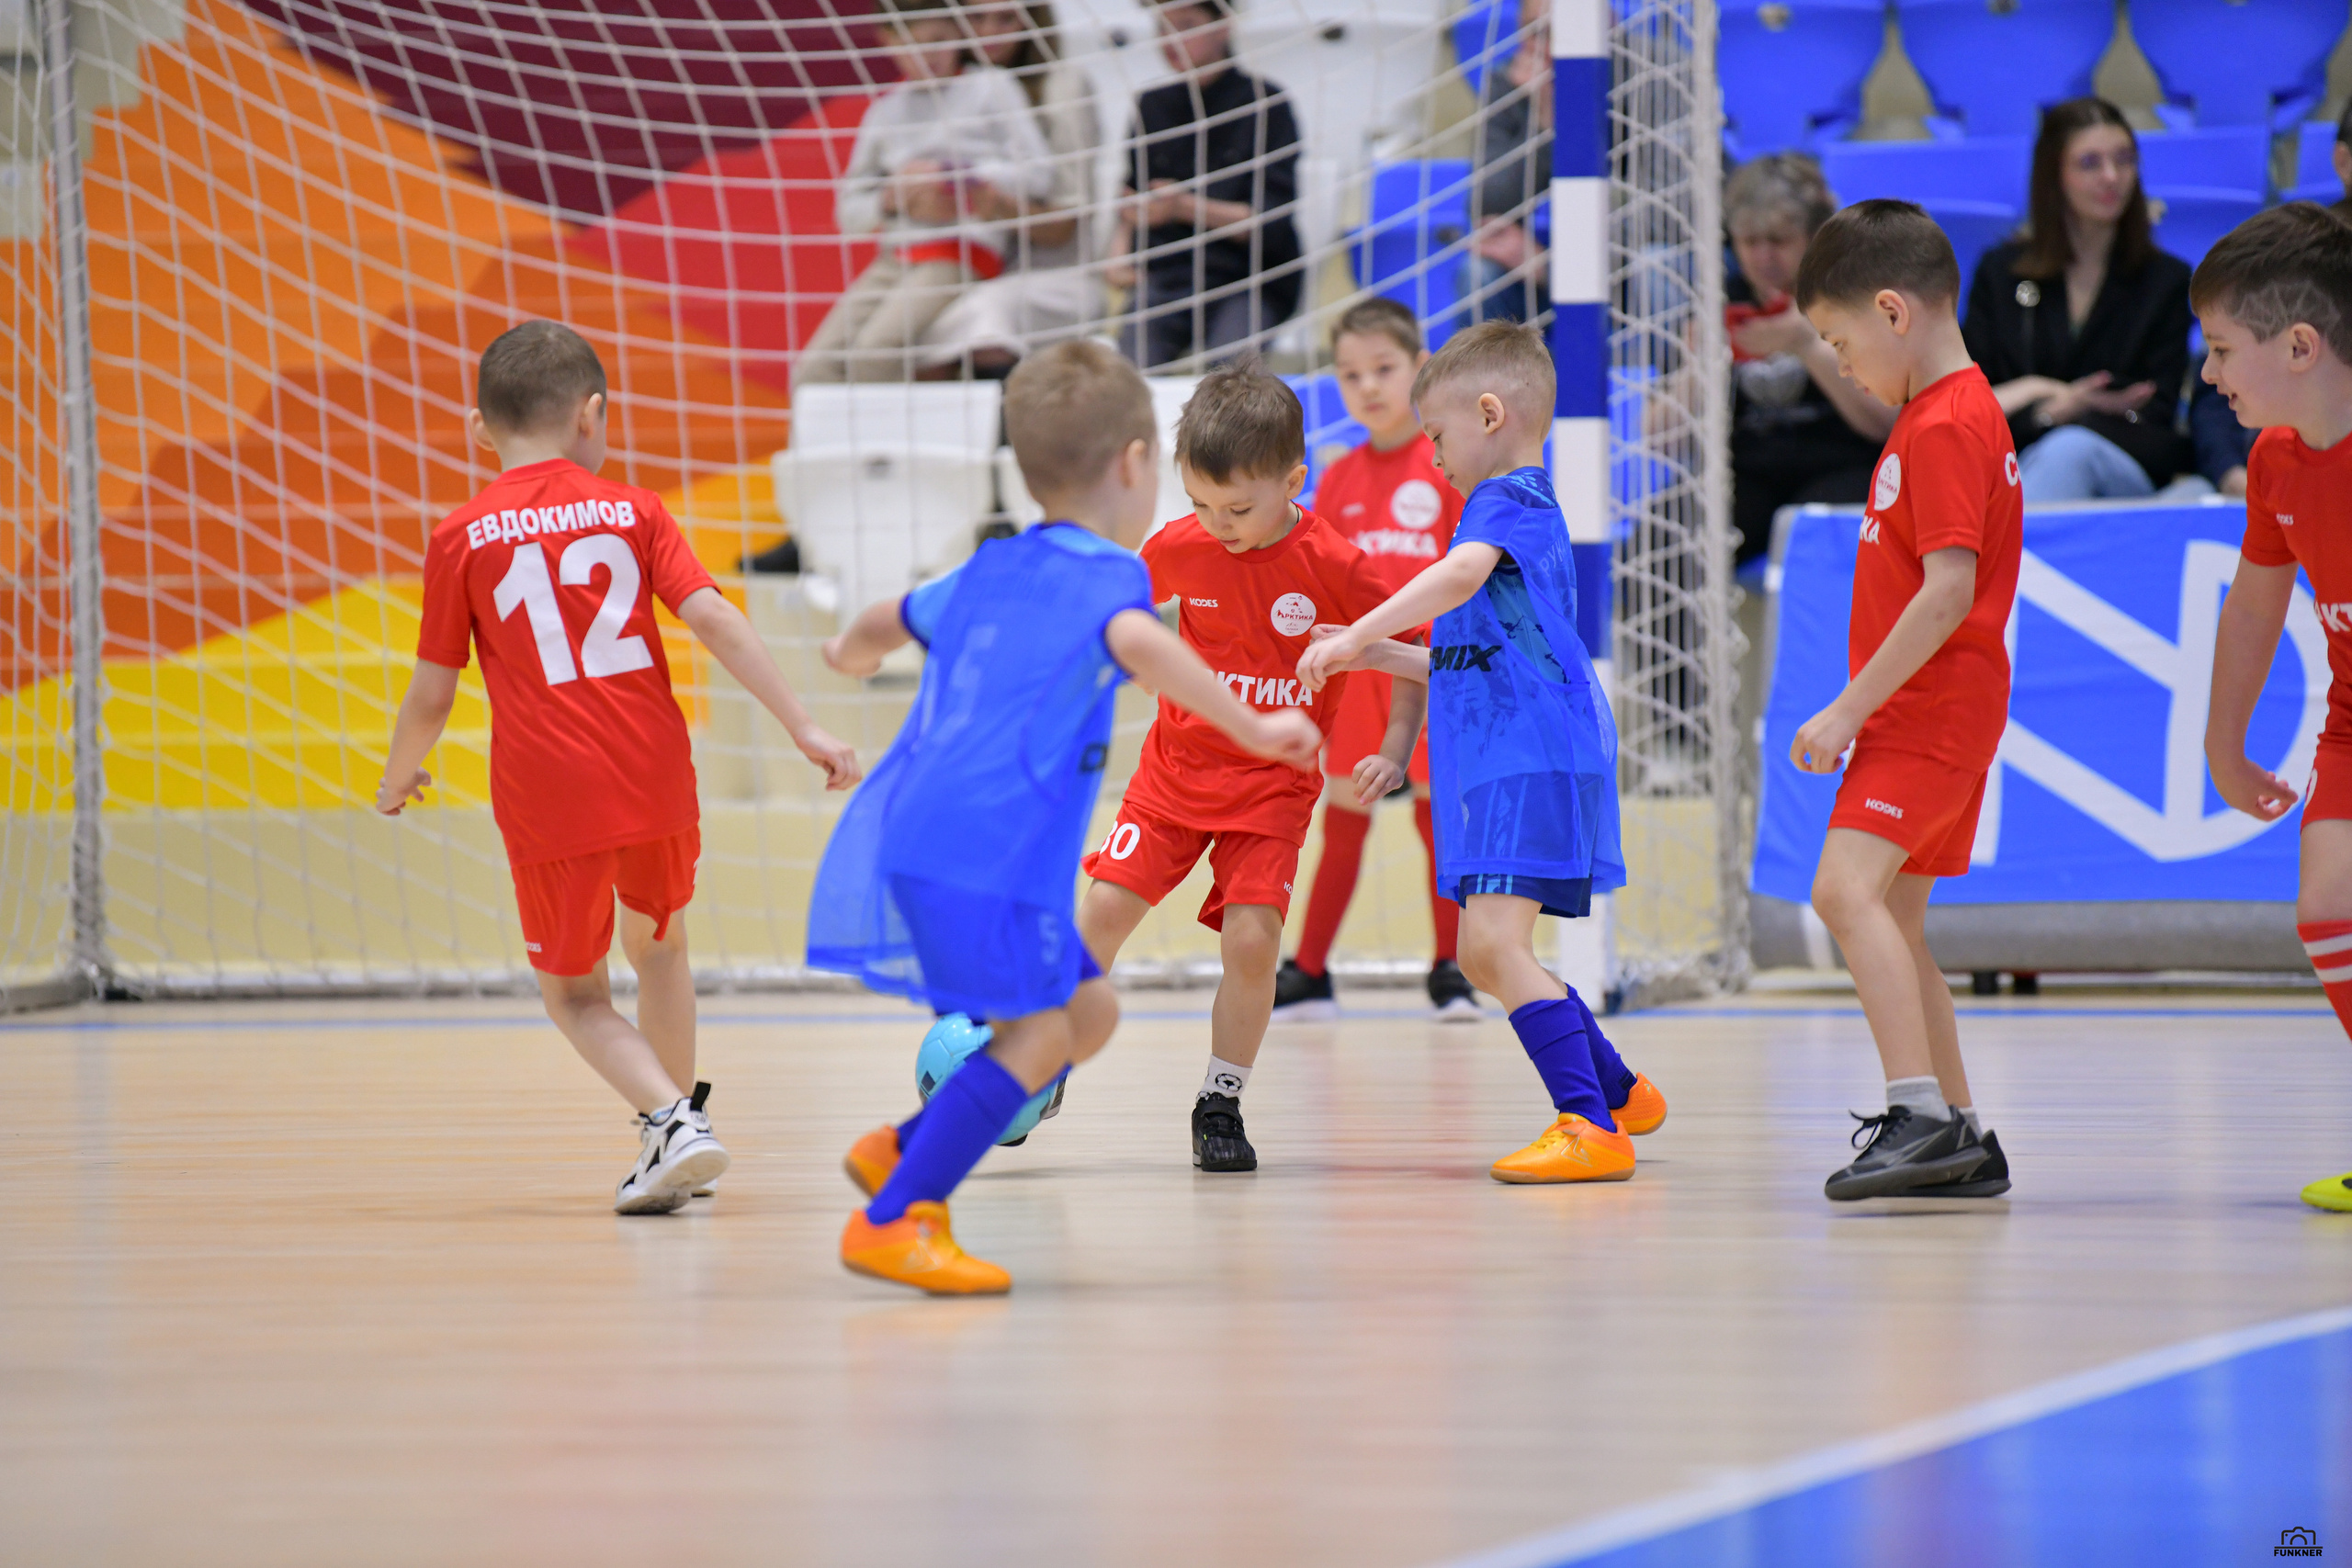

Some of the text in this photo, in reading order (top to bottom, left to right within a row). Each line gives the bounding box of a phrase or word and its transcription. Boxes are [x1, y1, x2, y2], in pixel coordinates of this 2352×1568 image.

[466, 499, 636, 550] ЕВДОКИМОВ
[492, 533, 654, 686] 12
[1189, 597, 1218, 608] KODES
[1429, 645, 1502, 677] MIX
[1865, 797, 1905, 819] KODES
